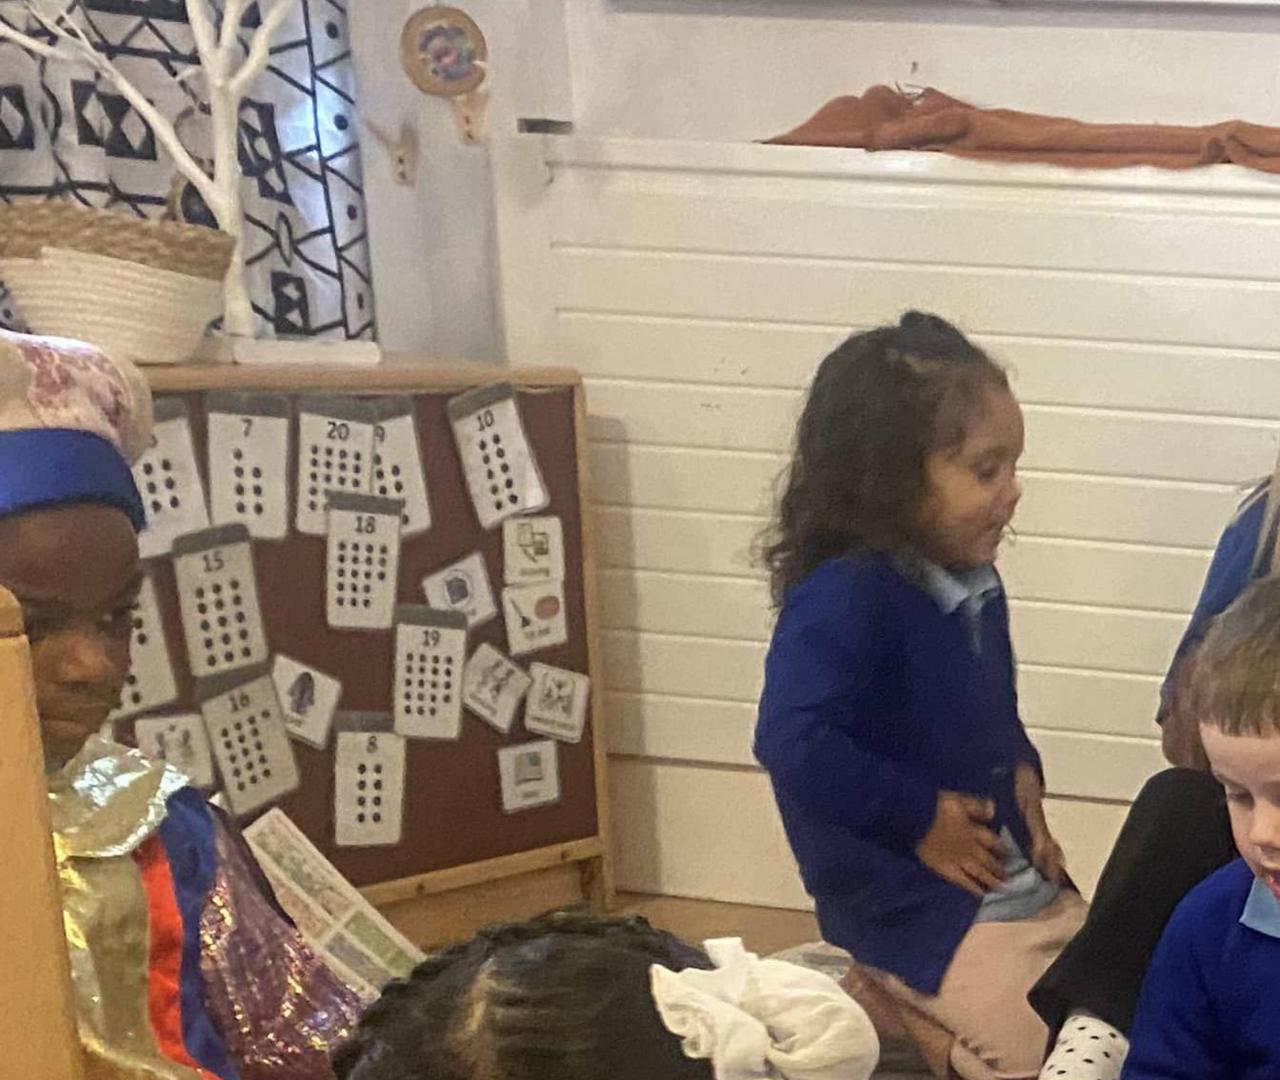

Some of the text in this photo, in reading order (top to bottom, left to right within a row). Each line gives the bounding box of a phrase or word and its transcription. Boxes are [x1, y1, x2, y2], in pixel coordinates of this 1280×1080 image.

[240, 418, 253, 437] 7
[326, 420, 350, 440] 20
[476, 409, 495, 432] 10
[354, 515, 376, 534] 18
[202, 552, 225, 573] 15
[421, 629, 441, 647] 19
[366, 735, 379, 753] 8
